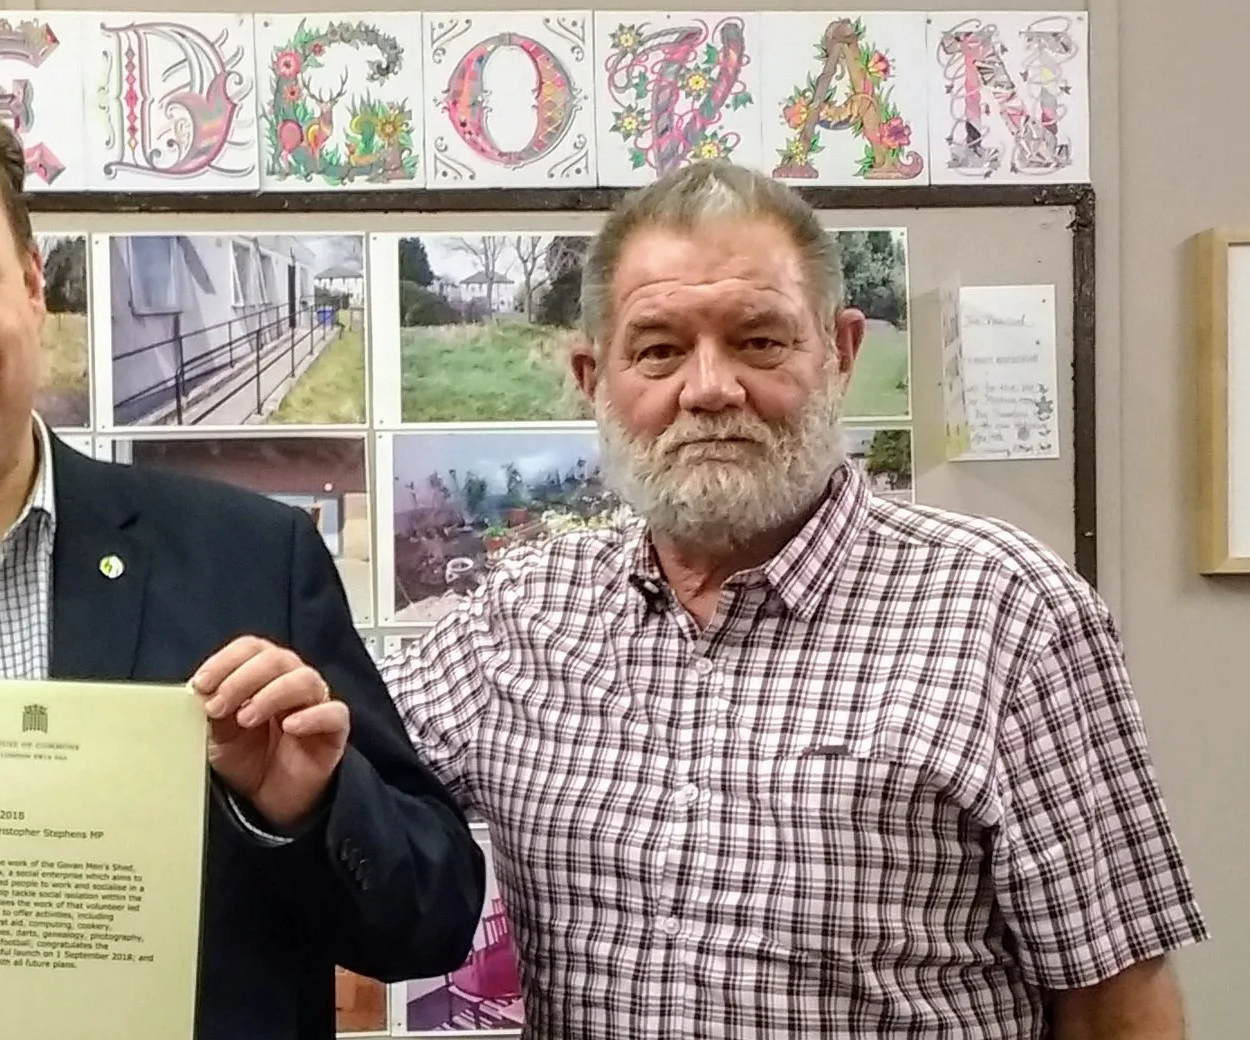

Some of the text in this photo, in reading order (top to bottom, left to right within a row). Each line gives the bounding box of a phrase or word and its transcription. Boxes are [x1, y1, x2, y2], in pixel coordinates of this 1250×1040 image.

[43, 828, 88, 841] Stephens
[90, 830, 104, 840] MP
[7, 858, 28, 867] work
[40, 859, 55, 868] the
[56, 860, 84, 869] Govan
[86, 861, 110, 870] Men's
[16, 868, 40, 877] social
[41, 869, 83, 881] enterprise
[86, 871, 110, 880] which
[111, 872, 132, 881] aims
[10, 878, 39, 889] people
[51, 880, 72, 889] work
[74, 881, 90, 889] and
[92, 882, 128, 891] socialise
[11, 888, 36, 897] tackle
[38, 889, 62, 898] social
[64, 890, 99, 900] isolation
[101, 892, 127, 901] within
[128, 893, 142, 902] the
[17, 898, 31, 907] the
[33, 899, 54, 908] work
[66, 901, 83, 909] that
[86, 901, 125, 911] volunteer
[127, 903, 140, 911] led
[13, 908, 33, 917] offer
[77, 911, 114, 922] including
[36, 939, 93, 951] congratulates
[94, 942, 108, 950] the
[13, 948, 41, 957] launch
[64, 950, 109, 962] September
[138, 954, 154, 962] and
[13, 958, 24, 967] all
[25, 959, 51, 968] future
[52, 960, 76, 971] plans.
